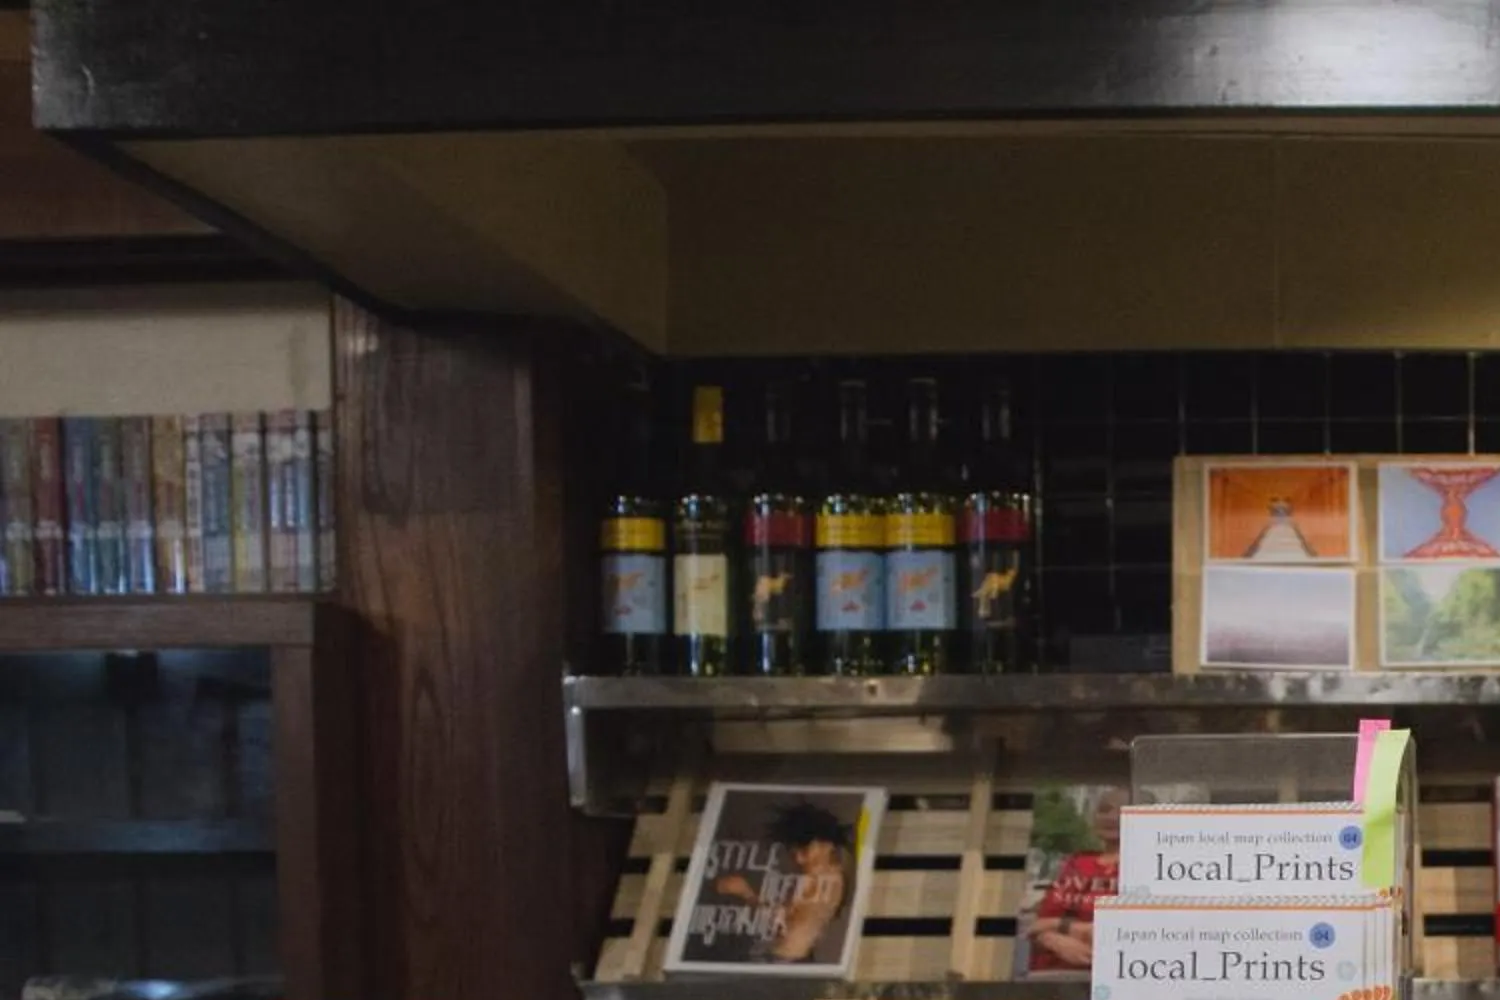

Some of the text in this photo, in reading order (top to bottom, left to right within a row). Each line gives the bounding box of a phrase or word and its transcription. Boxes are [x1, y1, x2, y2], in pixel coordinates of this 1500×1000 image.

[1156, 830, 1195, 847] Japan
[1197, 830, 1231, 844] local
[1233, 834, 1264, 847] map
[1266, 830, 1333, 844] collection
[1156, 853, 1355, 883] local_Prints
[1116, 927, 1158, 943] Japan
[1161, 927, 1196, 941] local
[1199, 931, 1231, 944] map
[1233, 927, 1303, 941] collection
[1116, 950, 1326, 982] local_Prints
